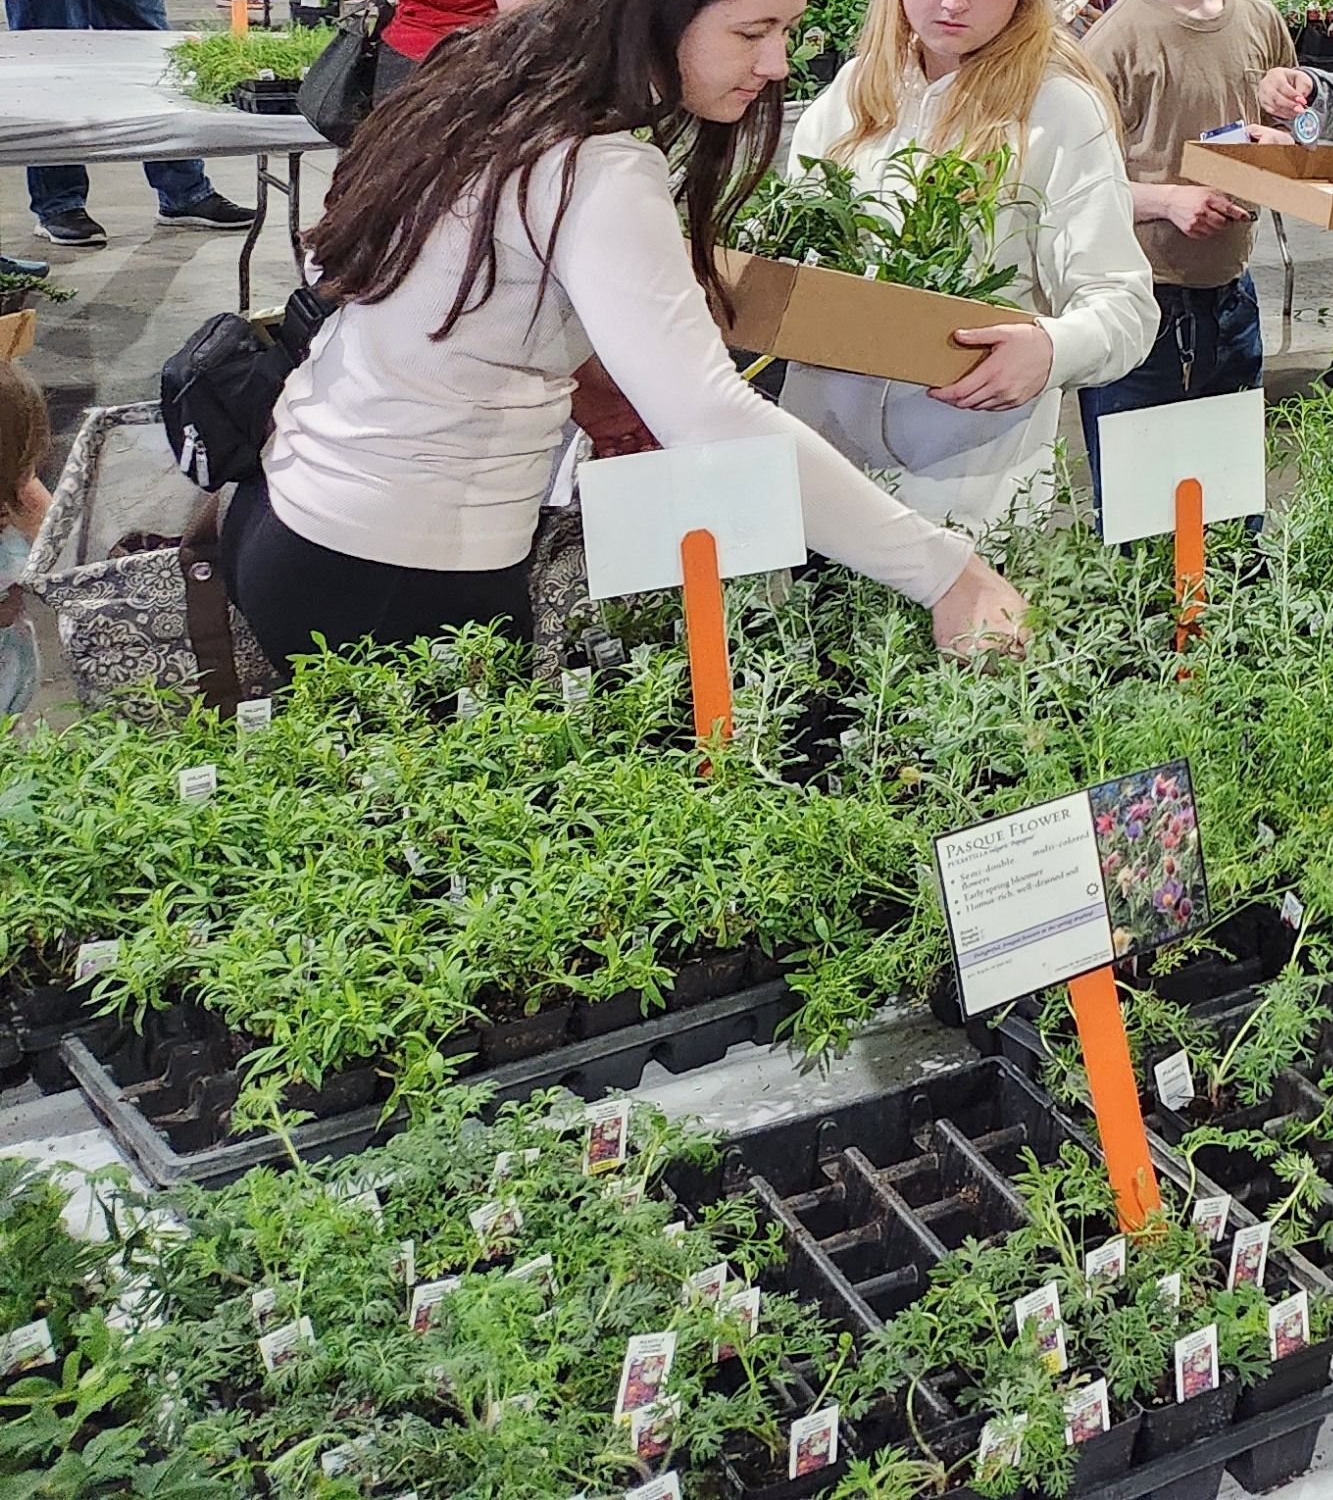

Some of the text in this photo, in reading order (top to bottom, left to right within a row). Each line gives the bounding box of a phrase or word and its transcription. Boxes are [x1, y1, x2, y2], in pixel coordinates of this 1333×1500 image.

[946, 808, 1071, 859] PASQUE FLOWER
[961, 876, 990, 891] flowers
[963, 869, 1044, 903] Early spring bloomer
